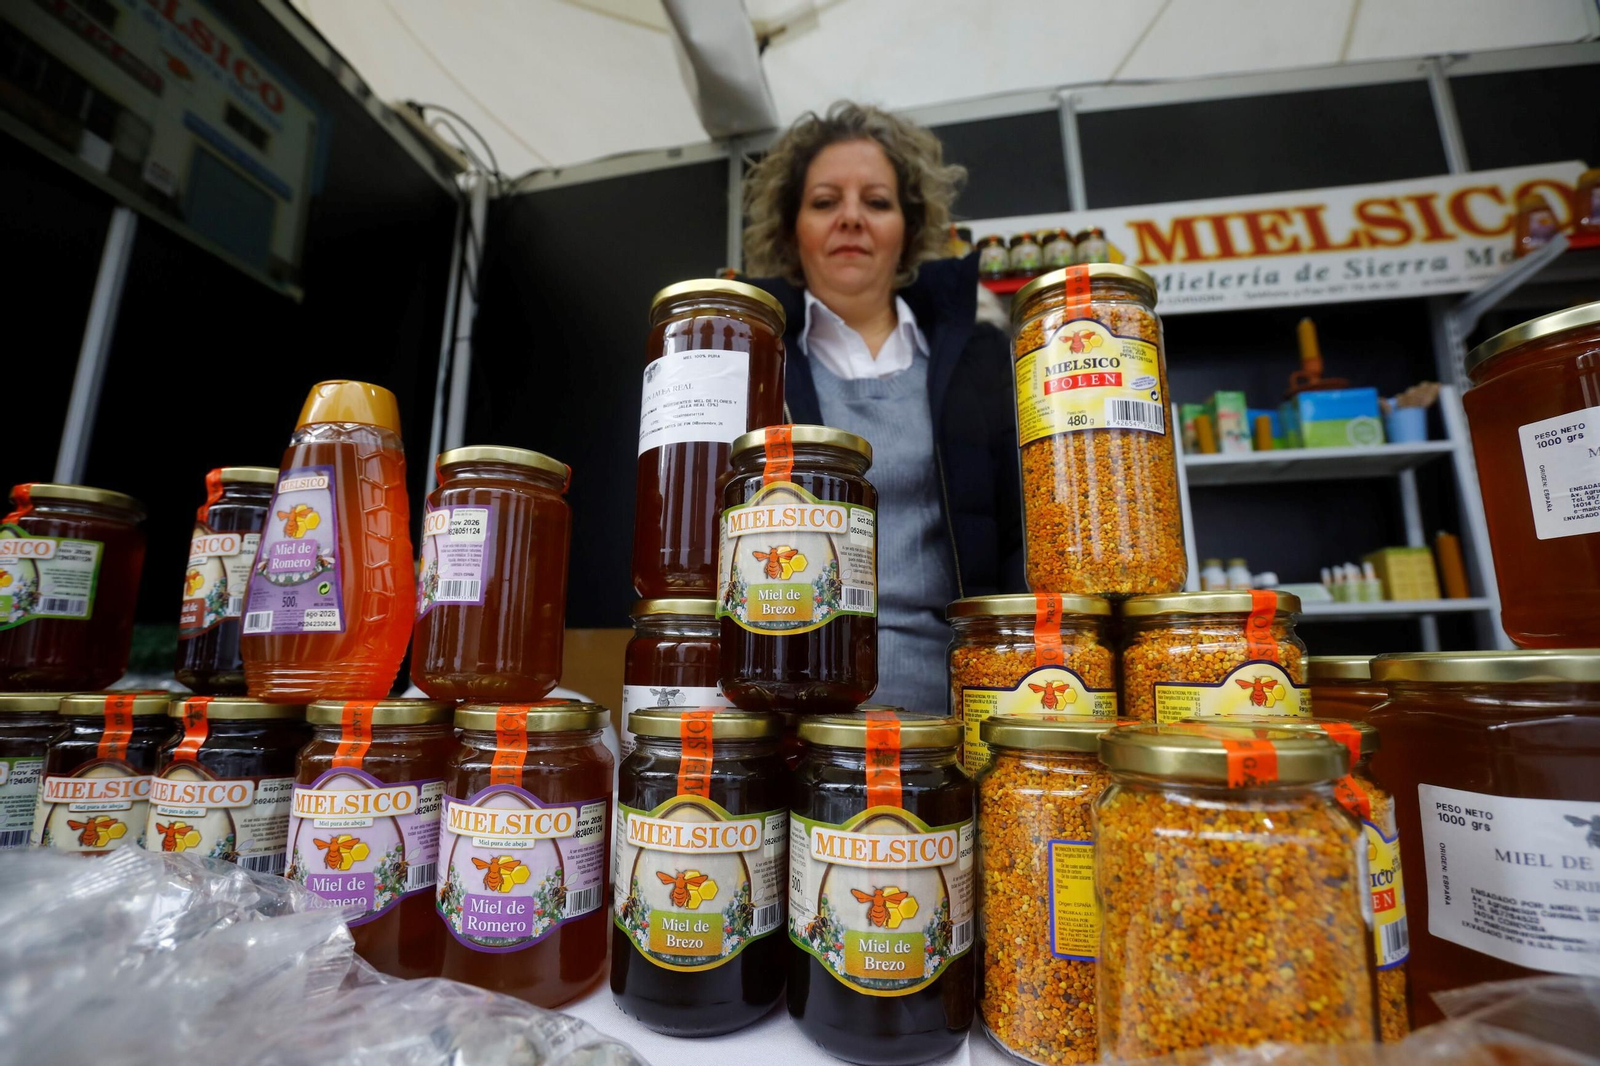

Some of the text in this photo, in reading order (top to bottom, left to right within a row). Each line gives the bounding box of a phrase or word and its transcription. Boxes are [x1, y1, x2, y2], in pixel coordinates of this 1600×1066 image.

[1126, 179, 1577, 265] MIELSICO
[1294, 263, 1329, 283] de
[1345, 254, 1450, 280] Sierra
[1045, 357, 1120, 376] MIELSICO
[672, 383, 694, 392] REAL
[1049, 373, 1117, 393] POLEN
[1067, 414, 1087, 426] 480
[1535, 423, 1585, 440] PESO NETO
[1537, 432, 1584, 448] 1000 grs
[280, 477, 326, 491] MIELSICO
[730, 508, 843, 533] MIELSICO
[275, 543, 311, 555] Miel de
[272, 558, 311, 570] Romero
[282, 596, 295, 607] 500
[758, 589, 800, 601] Miel de
[762, 604, 796, 615] Brezo
[151, 781, 247, 803] IELSICO
[295, 791, 412, 815] MIELSICO
[419, 796, 432, 804] nov
[1436, 802, 1493, 820] PESO NETO
[351, 820, 366, 828] abeja
[449, 807, 572, 835] MIELSICO
[577, 815, 602, 827] nov 2026
[1437, 812, 1491, 832] 1000 grs
[630, 819, 757, 849] MIELSICO
[512, 840, 527, 848] abeja
[816, 832, 953, 863] MIELSICO
[1495, 848, 1595, 871] MIEL DE
[1439, 842, 1451, 906] ORIGEN: ESPAÑA
[312, 877, 365, 892] Miel de
[791, 875, 800, 893] 500
[470, 899, 525, 914] Miel de
[467, 916, 526, 932] Romero
[661, 918, 709, 932] Miel de
[666, 935, 703, 949] Brezo
[859, 939, 911, 953] Miel de
[864, 956, 905, 971] Brezo
